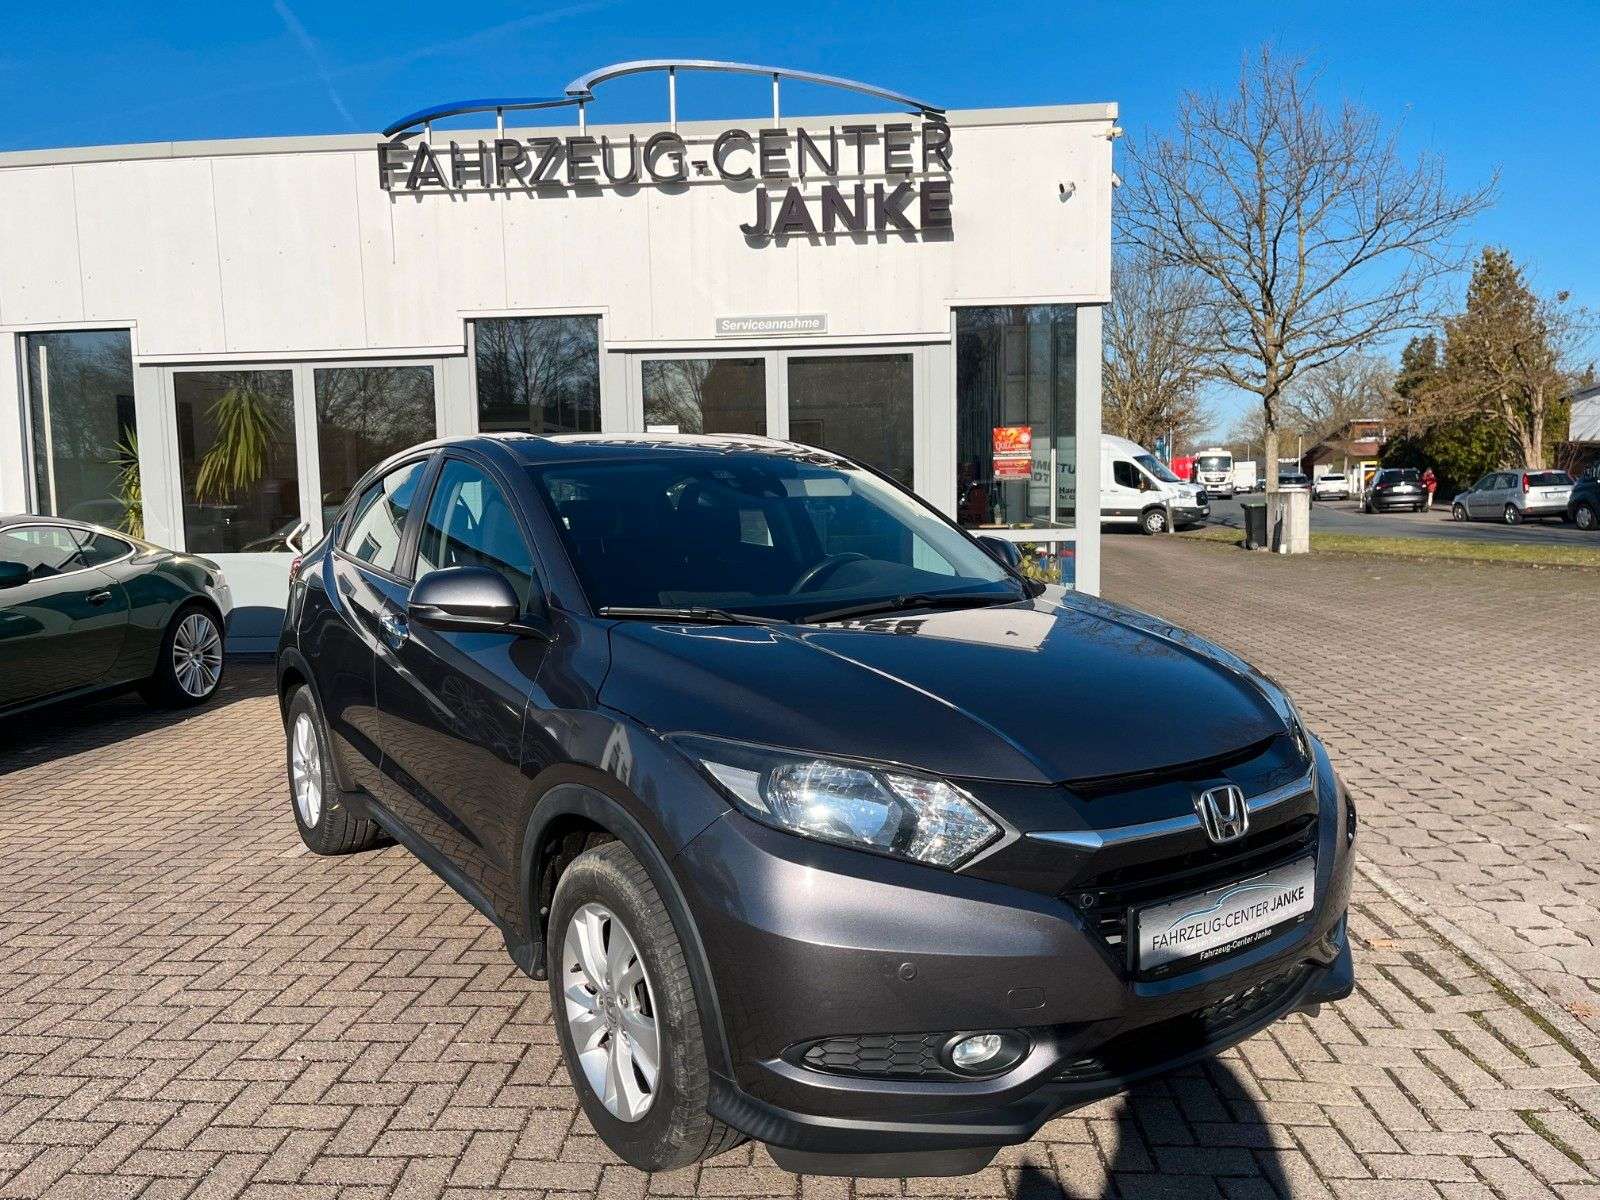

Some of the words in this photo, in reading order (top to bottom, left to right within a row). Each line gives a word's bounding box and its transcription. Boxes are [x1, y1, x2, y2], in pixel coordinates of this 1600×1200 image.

[377, 122, 952, 191] FAHRZEUG-CENTER
[740, 180, 952, 238] JANKE
[721, 318, 820, 331] Serviceannahme
[1152, 901, 1269, 951] FAHRZEUG-CENTER
[1270, 886, 1305, 913] JANKE
[1199, 933, 1253, 962] Fahrzeug-Center
[1253, 928, 1272, 945] Janke
